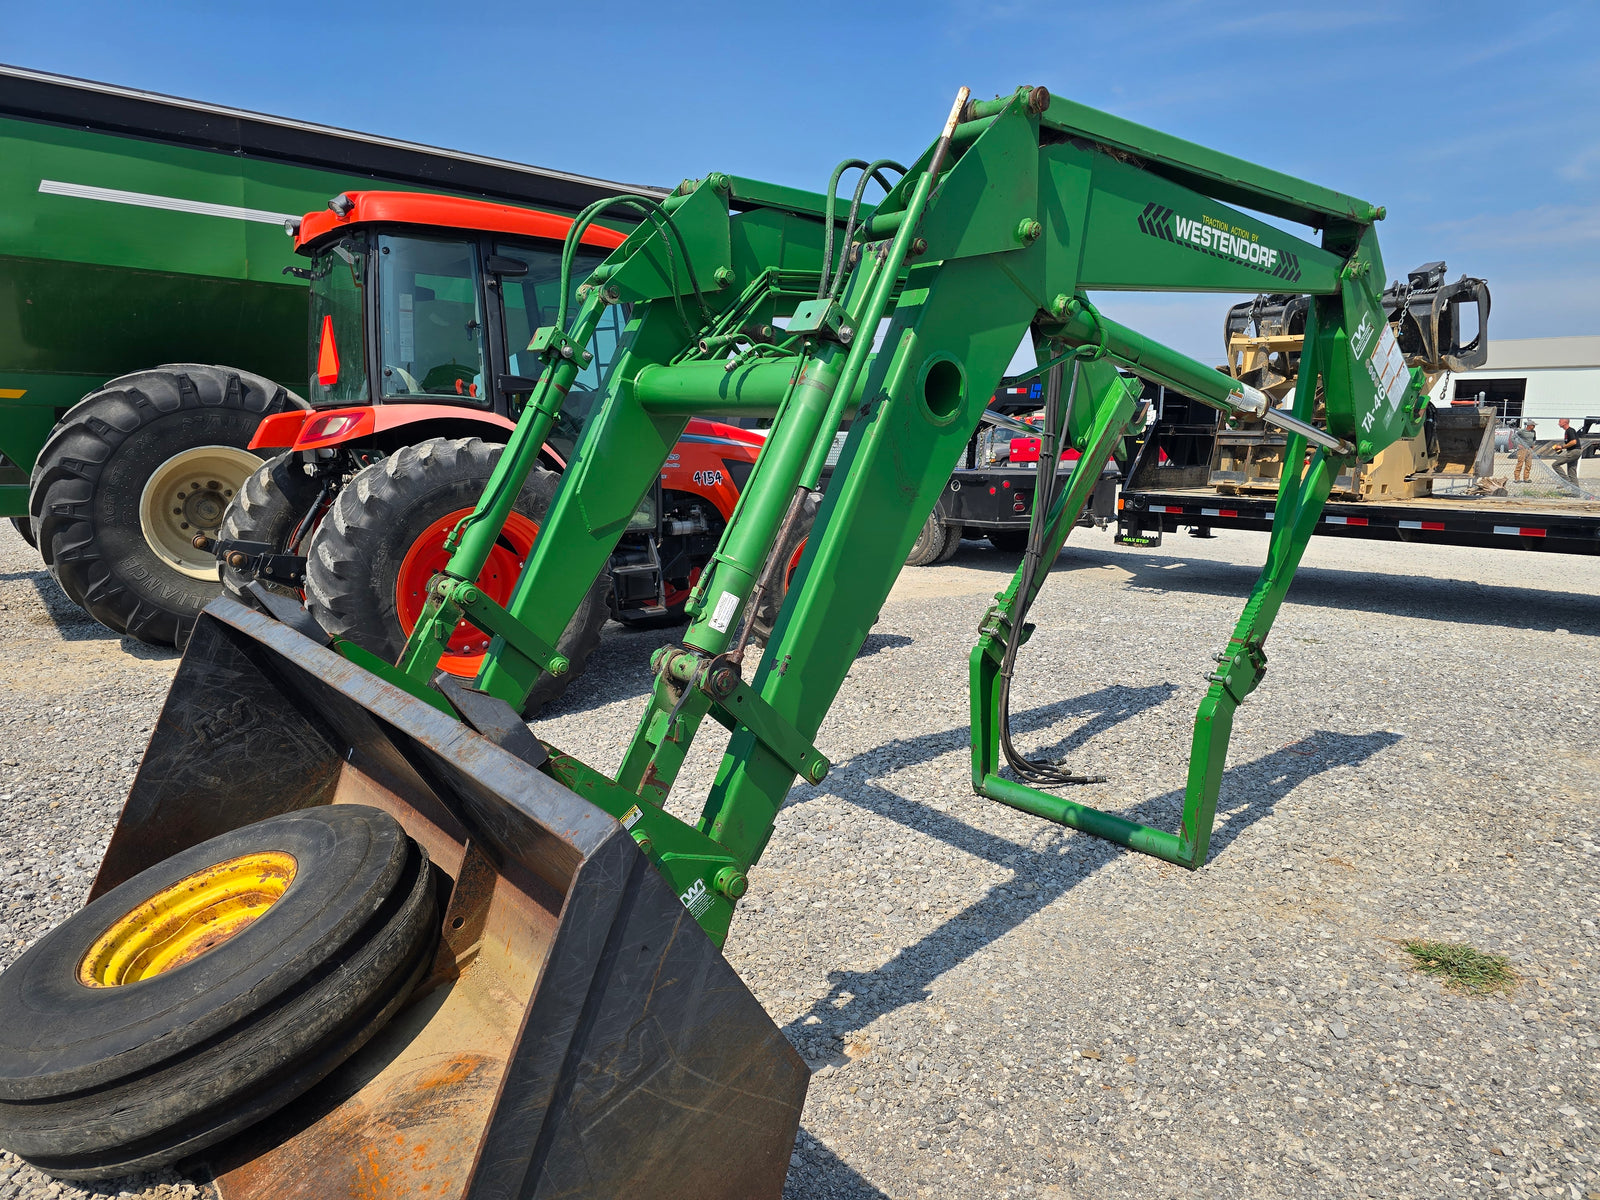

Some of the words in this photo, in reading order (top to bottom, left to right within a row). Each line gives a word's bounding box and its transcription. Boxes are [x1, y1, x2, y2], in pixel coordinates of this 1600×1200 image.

[1175, 214, 1278, 268] WESTENDORF
[1202, 214, 1229, 232] TRACTION
[1230, 223, 1249, 240] ACTION
[1251, 233, 1259, 243] BY
[1361, 383, 1386, 434] TA-46
[693, 470, 723, 486] 4154
[119, 555, 213, 610] LIANCE
